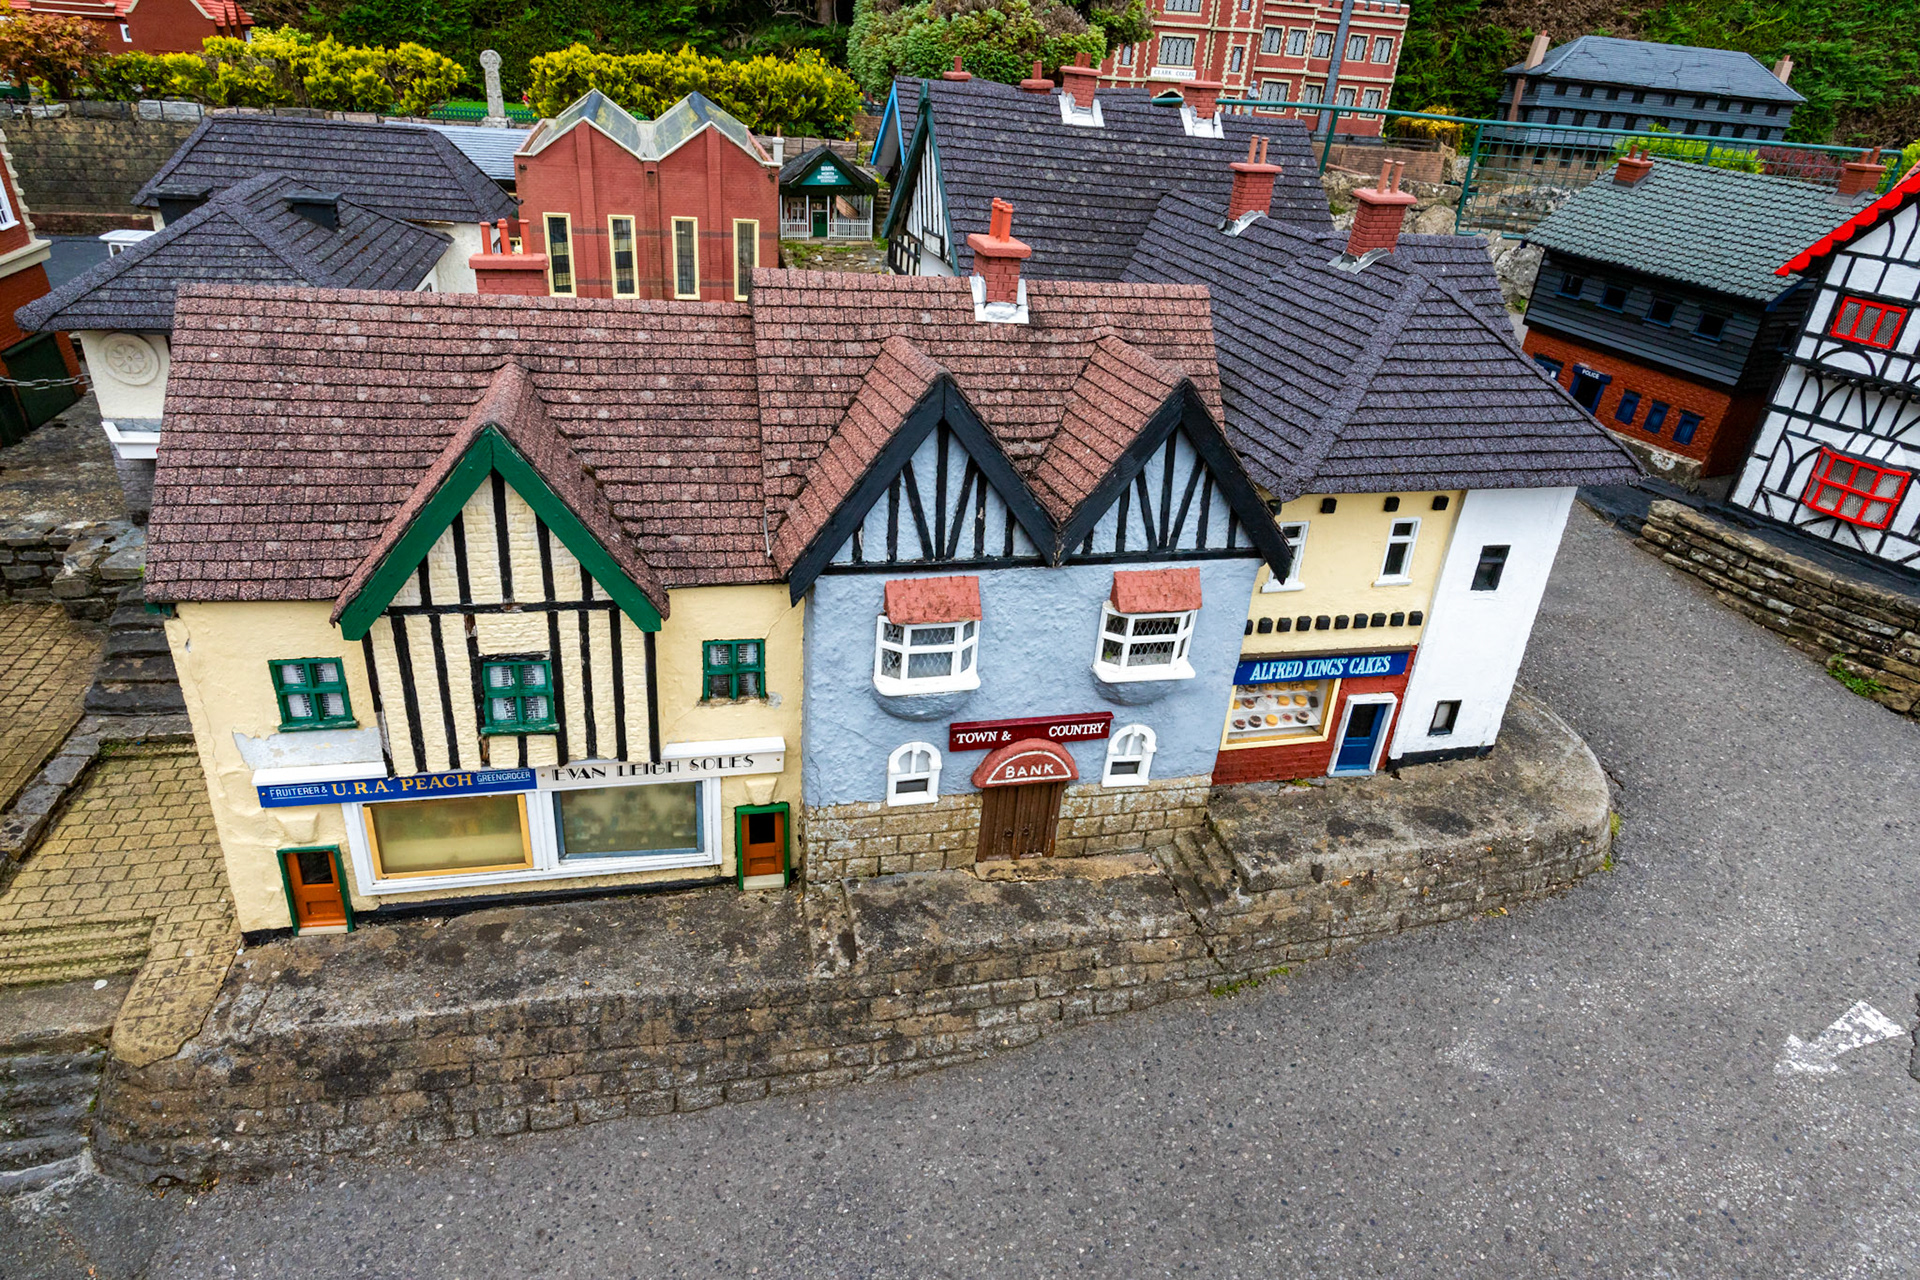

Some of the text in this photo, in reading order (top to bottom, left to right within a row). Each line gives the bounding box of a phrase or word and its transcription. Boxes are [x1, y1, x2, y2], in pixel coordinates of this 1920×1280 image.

[1581, 369, 1600, 379] POLICE
[1249, 660, 1304, 681] ALFRED
[1348, 655, 1392, 674] CAKES
[956, 722, 1105, 744] TOWN & COUNTRY
[551, 754, 754, 781] EVAN LEIGH SOLES
[1005, 763, 1055, 779] BANK
[269, 771, 531, 798] FRUITERER & U.R.A. PEACH GREENGROCER
